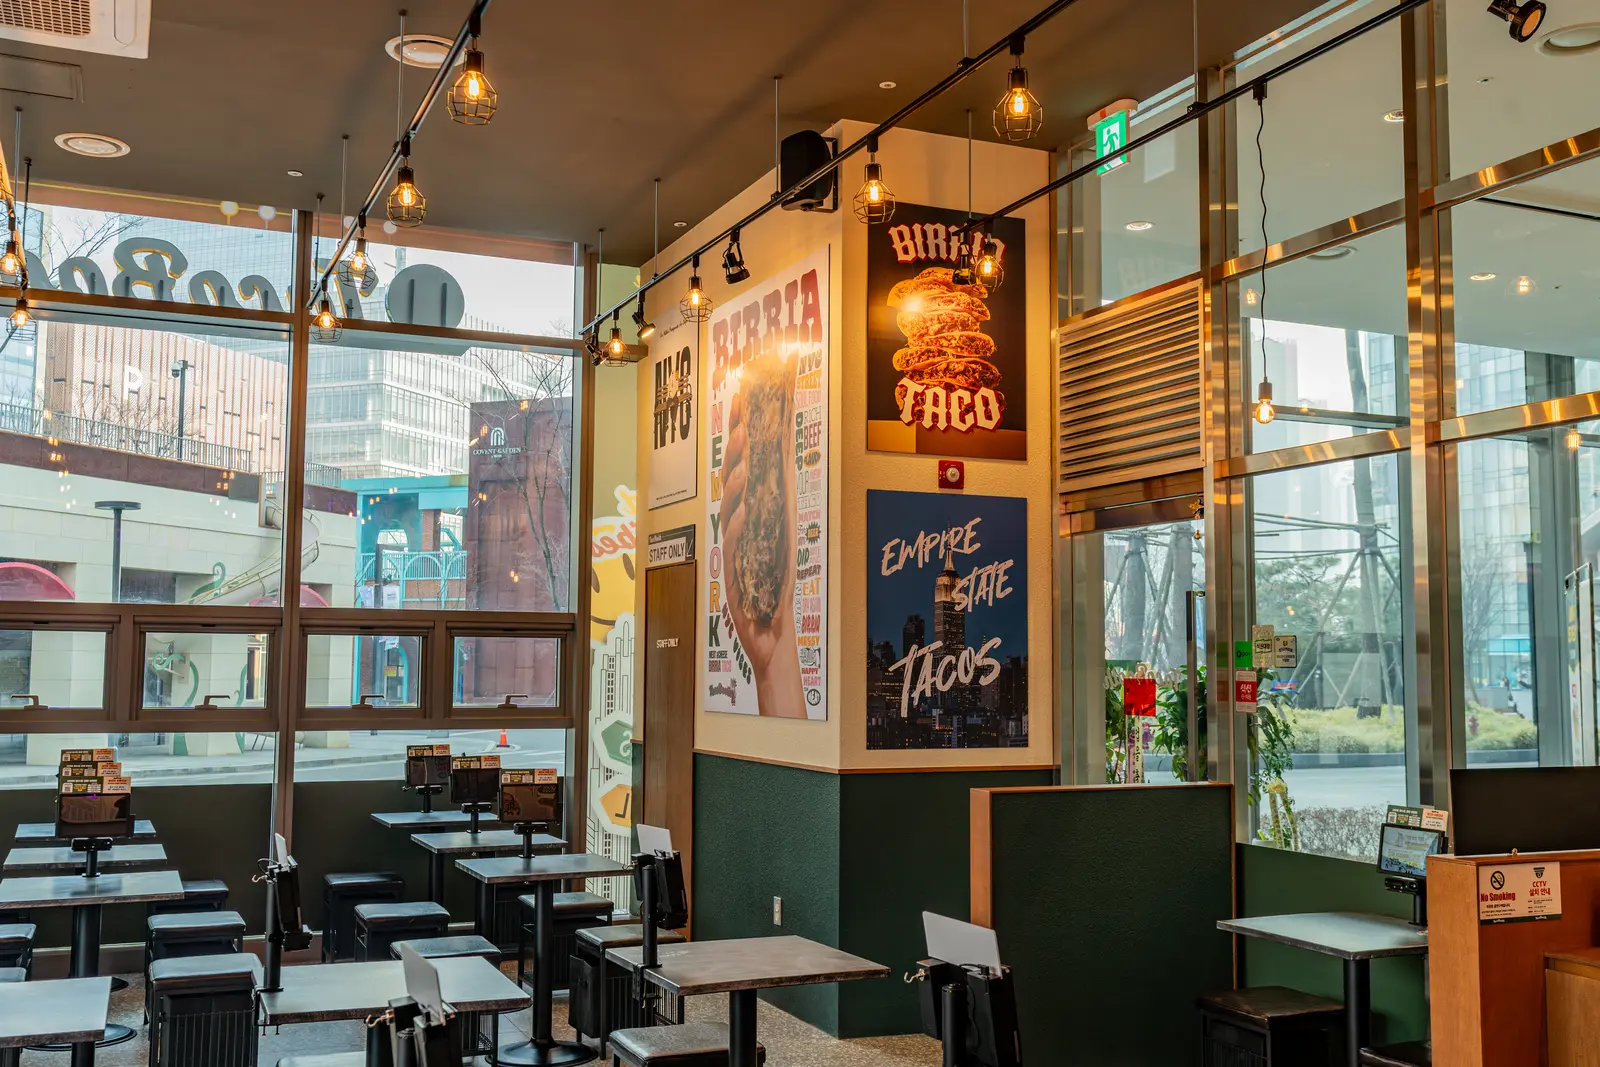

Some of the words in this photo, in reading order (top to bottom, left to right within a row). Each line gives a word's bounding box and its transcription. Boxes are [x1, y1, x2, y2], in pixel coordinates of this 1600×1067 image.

[713, 269, 822, 393] BIRRIA
[897, 377, 1003, 433] TACO
[804, 406, 822, 425] RICH
[804, 421, 822, 450] BEEF
[649, 546, 668, 563] STAFF
[668, 543, 685, 559] ONLY
[881, 517, 982, 577] EMPIRE
[796, 564, 822, 581] REPEAT
[802, 577, 821, 597] EAT
[951, 558, 1014, 613] STATE
[656, 639, 667, 649] STAFF
[888, 637, 1002, 718] TACOS
[1481, 893, 1488, 902] No
[1489, 892, 1516, 902] Smoking
[1529, 888, 1539, 896] 설치
[1540, 888, 1551, 896] 안내
